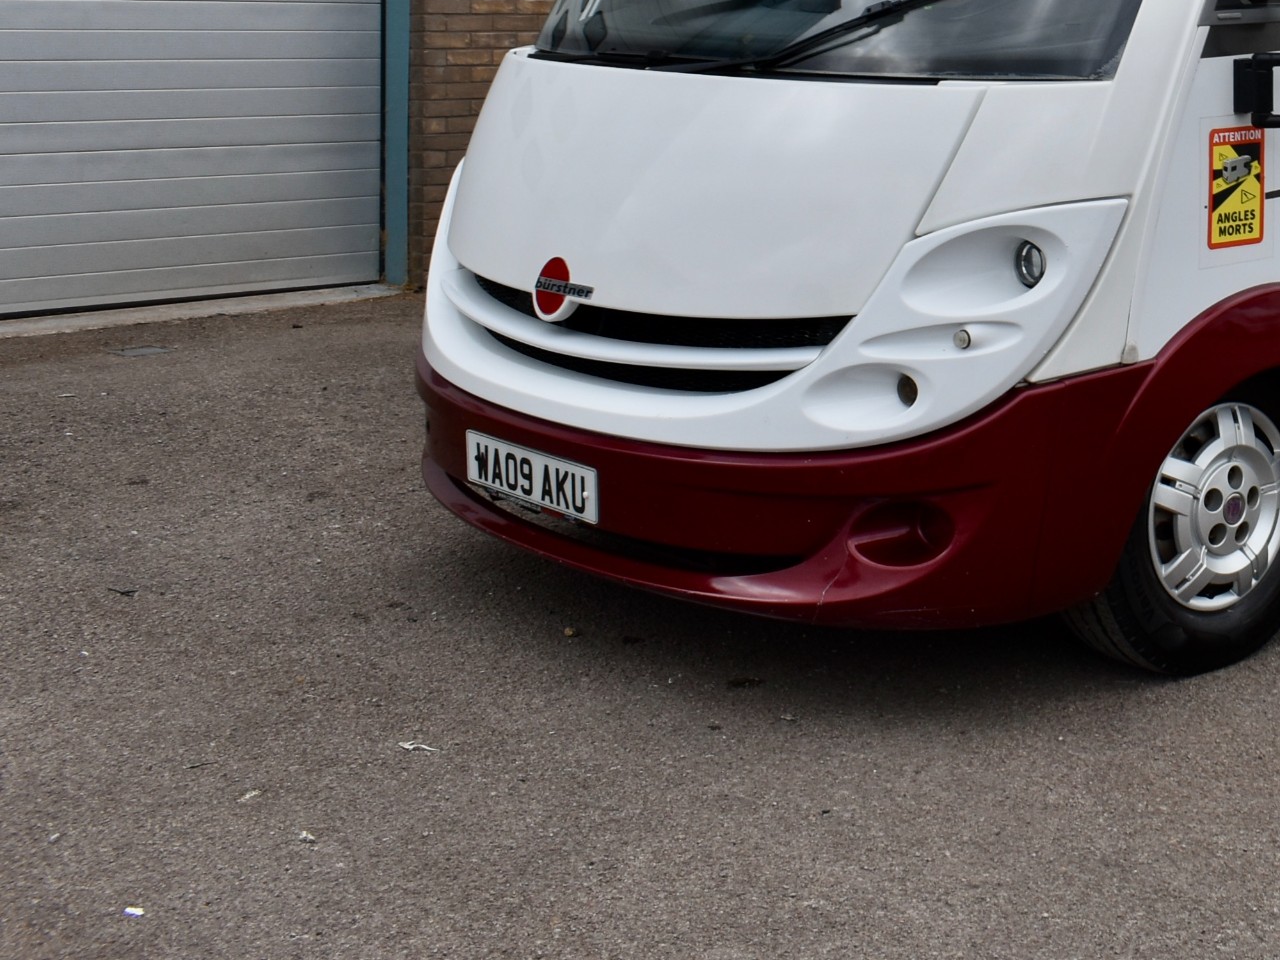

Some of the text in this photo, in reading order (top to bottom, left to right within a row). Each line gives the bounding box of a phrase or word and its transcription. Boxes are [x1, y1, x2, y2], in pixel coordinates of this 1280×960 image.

[1213, 129, 1262, 143] ATTENTION
[1217, 209, 1256, 224] ANGLES
[1218, 222, 1254, 237] MORTS
[535, 276, 593, 298] bürstner
[475, 442, 586, 514] WA09 AKU
